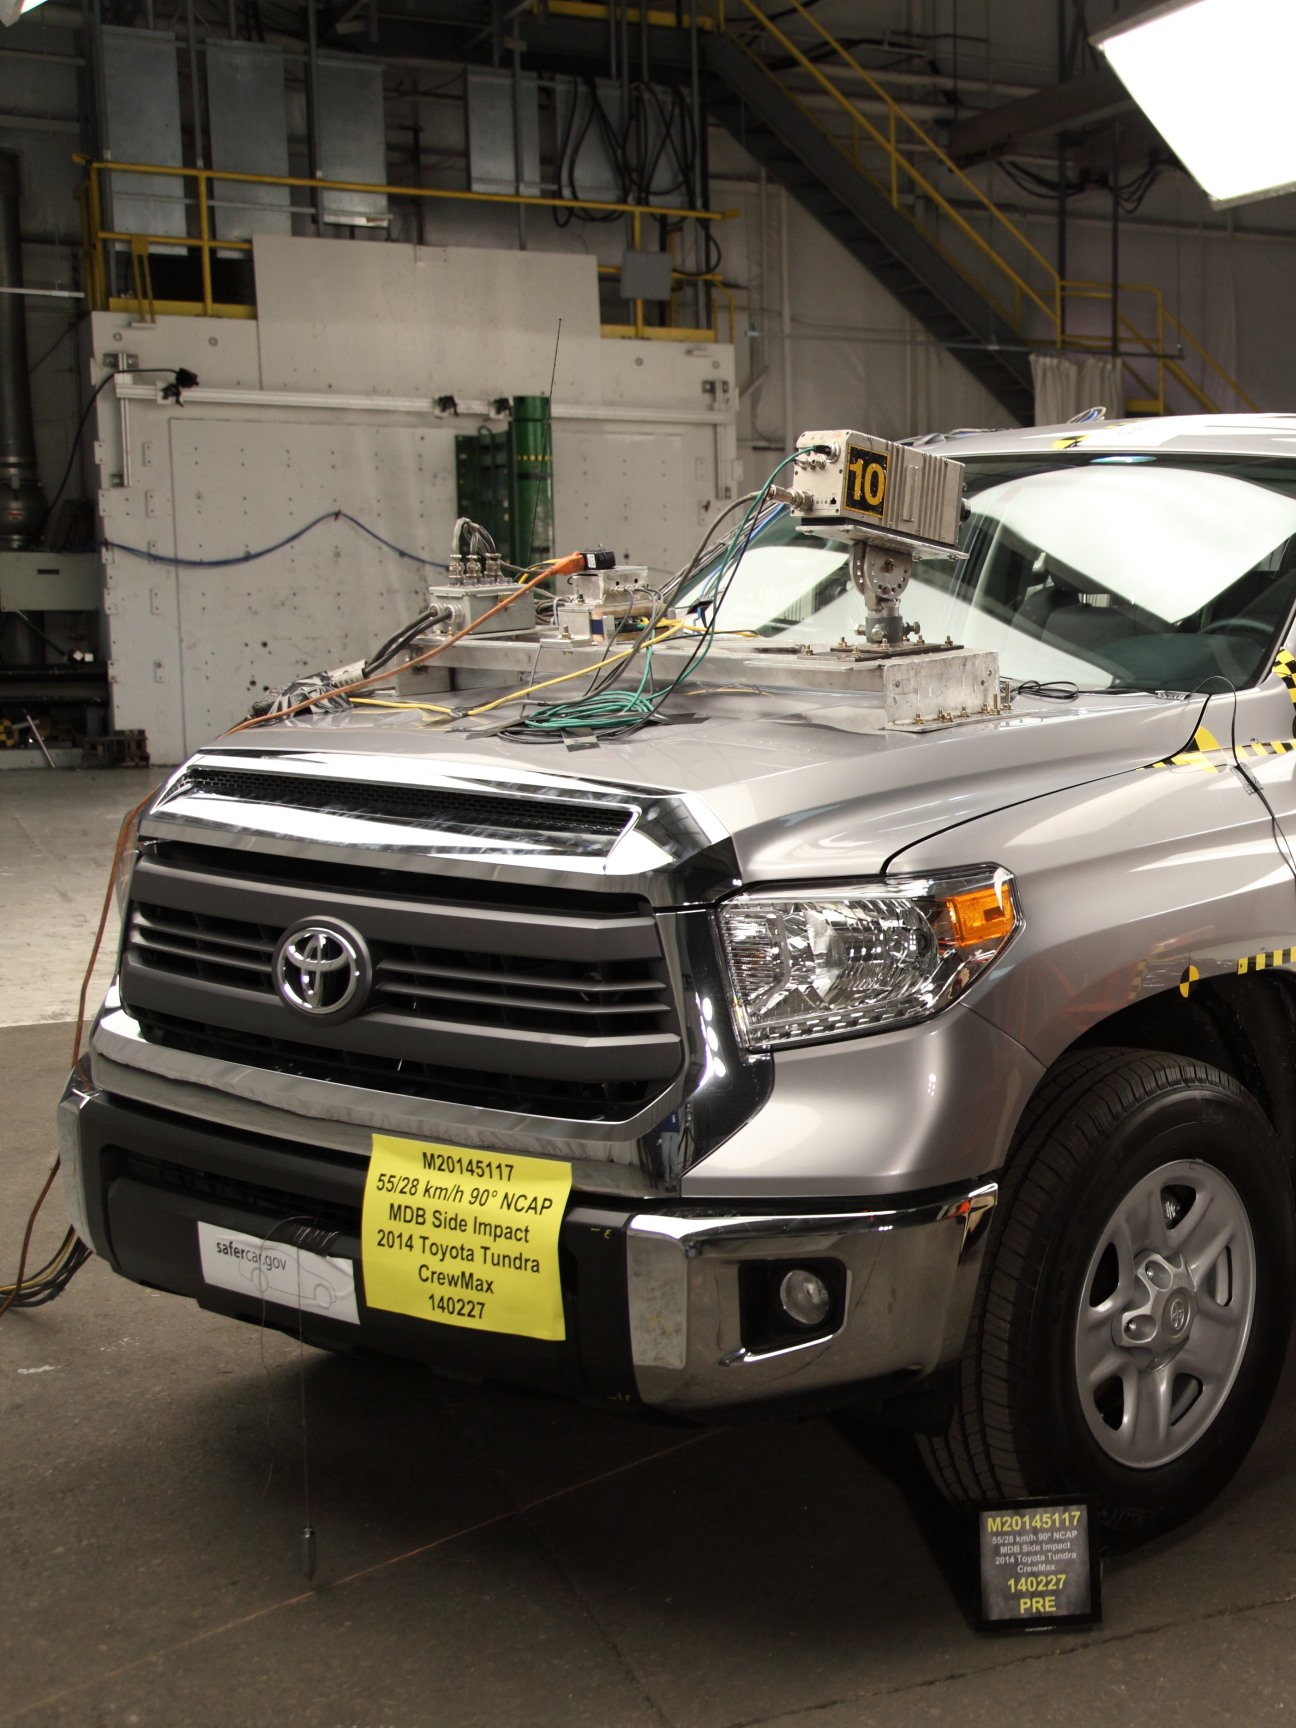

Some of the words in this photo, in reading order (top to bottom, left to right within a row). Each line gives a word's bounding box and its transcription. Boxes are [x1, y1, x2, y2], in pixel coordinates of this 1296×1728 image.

[850, 458, 886, 506] 10
[422, 1151, 514, 1182] M20145117
[376, 1173, 419, 1196] 55/28
[423, 1180, 464, 1203] km/h
[468, 1187, 498, 1206] 90°
[500, 1192, 553, 1216] NCAP
[389, 1203, 426, 1225] MDB
[432, 1210, 468, 1232] Side
[473, 1216, 530, 1243] Impact
[216, 1241, 287, 1271] safercar.gov
[377, 1229, 414, 1252] 2014
[419, 1236, 475, 1262] Toyota
[480, 1246, 540, 1273] Tundra
[418, 1264, 495, 1294] CrewMax
[428, 1293, 486, 1319] 140227
[987, 1511, 1081, 1532] M20145117
[992, 1535, 1014, 1545] 55/28
[1016, 1534, 1036, 1543] km/h
[1053, 1530, 1078, 1540] NCAP
[1000, 1545, 1020, 1554] MDB
[1022, 1543, 1041, 1552] Side
[1042, 1541, 1071, 1552] Impact
[995, 1555, 1015, 1565] 2014
[1017, 1553, 1046, 1564] Toyota
[1047, 1551, 1077, 1561] Tundra
[1017, 1563, 1056, 1573] CrewMax
[1007, 1574, 1067, 1593] 140227
[1020, 1596, 1057, 1614] PRE
